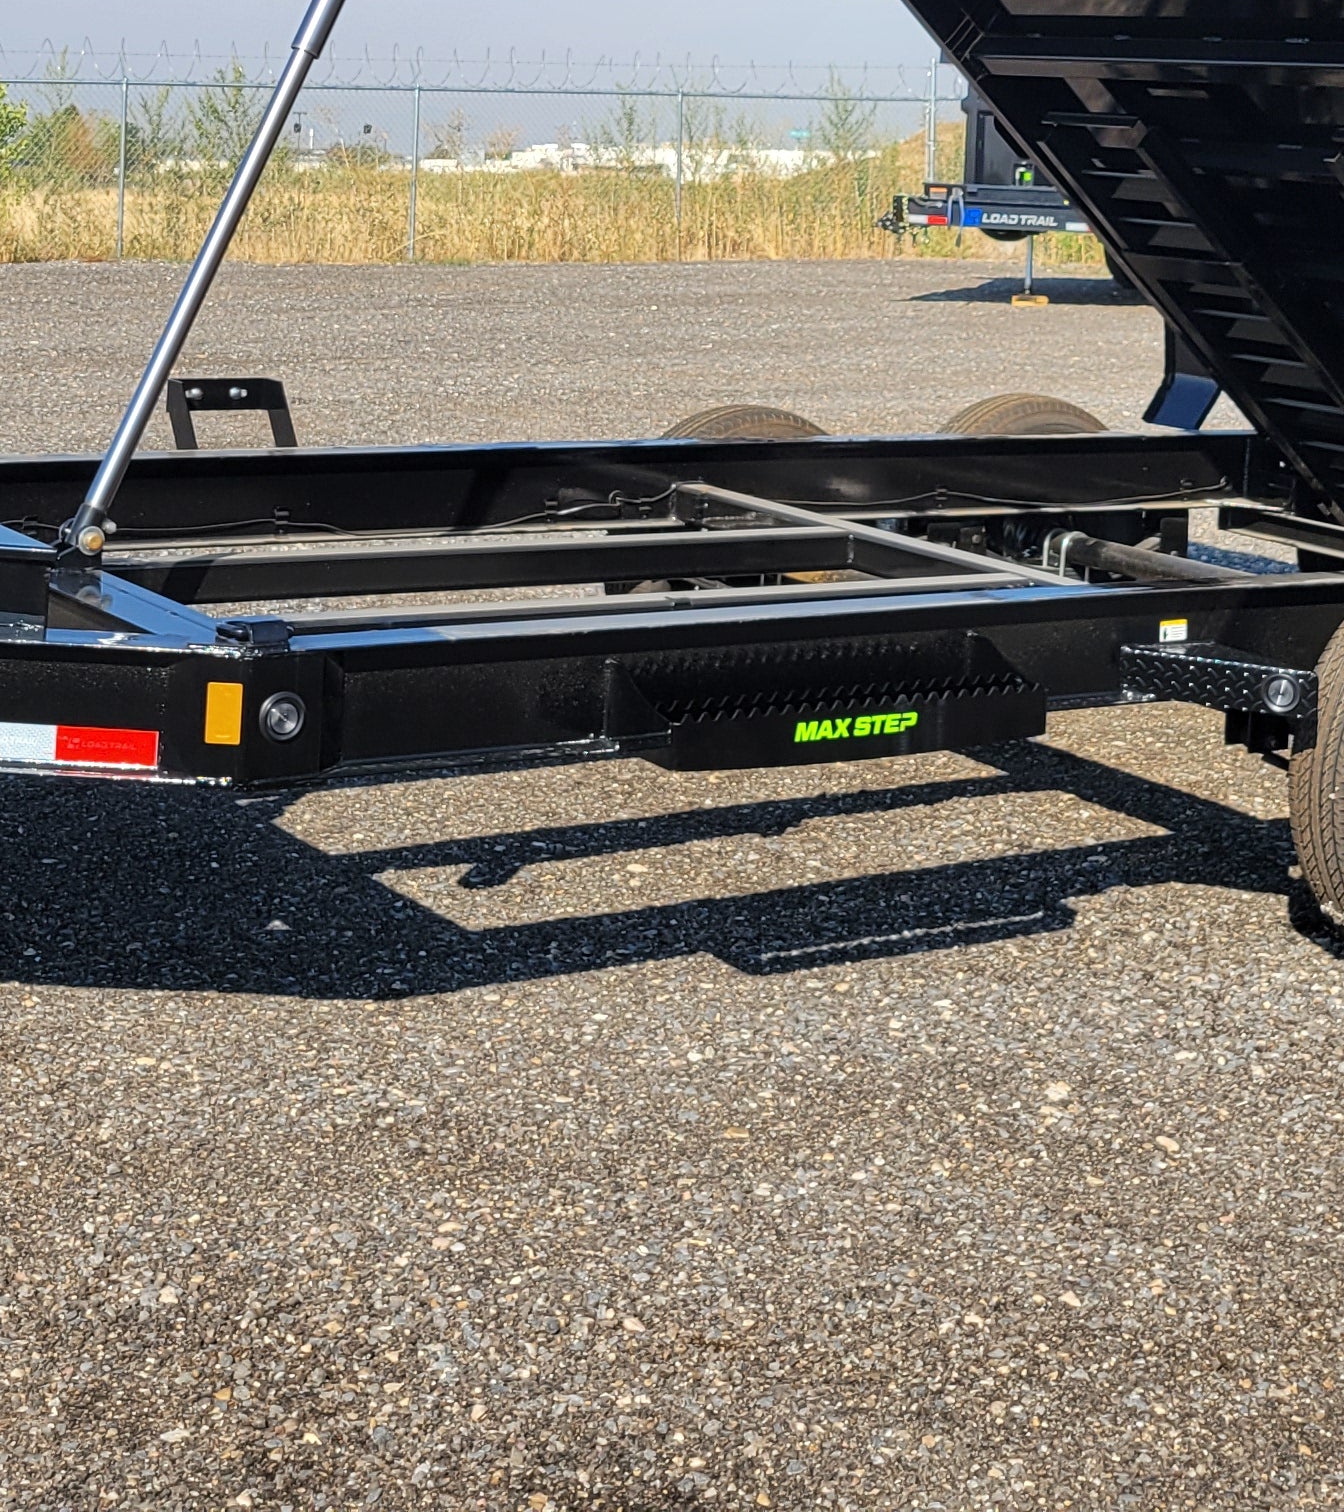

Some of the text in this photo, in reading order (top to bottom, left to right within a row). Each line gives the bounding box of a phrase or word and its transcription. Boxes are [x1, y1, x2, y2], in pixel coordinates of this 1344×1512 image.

[982, 212, 1058, 227] LOAD TRAIL
[794, 711, 918, 743] MAX STEP
